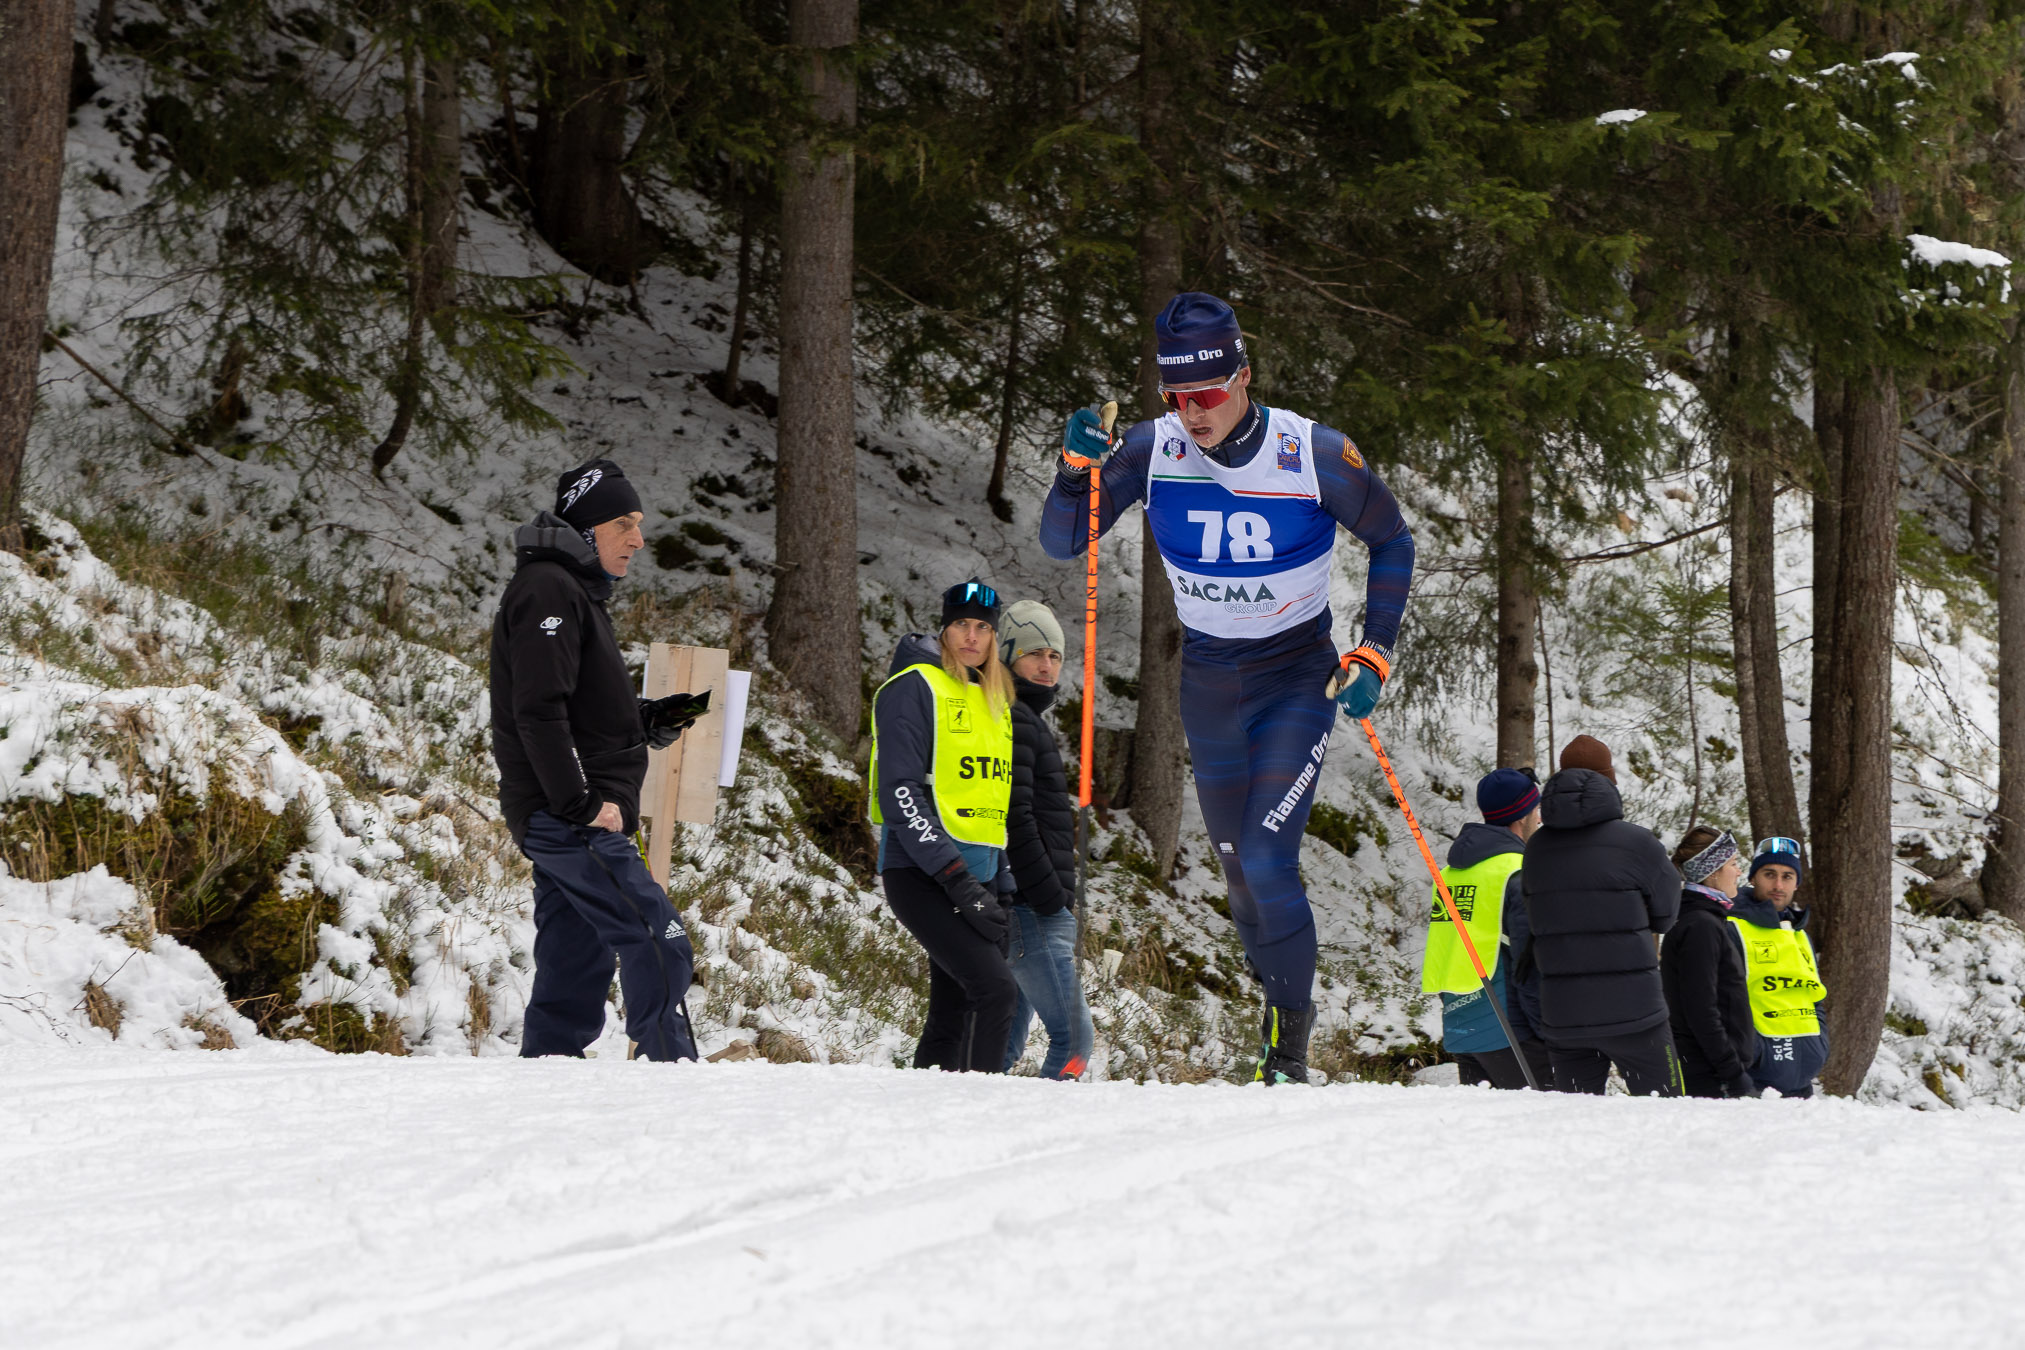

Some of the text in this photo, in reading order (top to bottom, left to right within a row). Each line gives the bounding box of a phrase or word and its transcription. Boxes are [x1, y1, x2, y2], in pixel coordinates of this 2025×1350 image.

[1198, 348, 1224, 361] Oro
[1187, 509, 1274, 563] 78
[1177, 575, 1277, 603] SACMA
[1224, 601, 1278, 614] GROUP
[1261, 732, 1329, 833] Fiamme Oro
[1457, 886, 1475, 897] FIS
[1772, 1045, 1784, 1061] Sci
